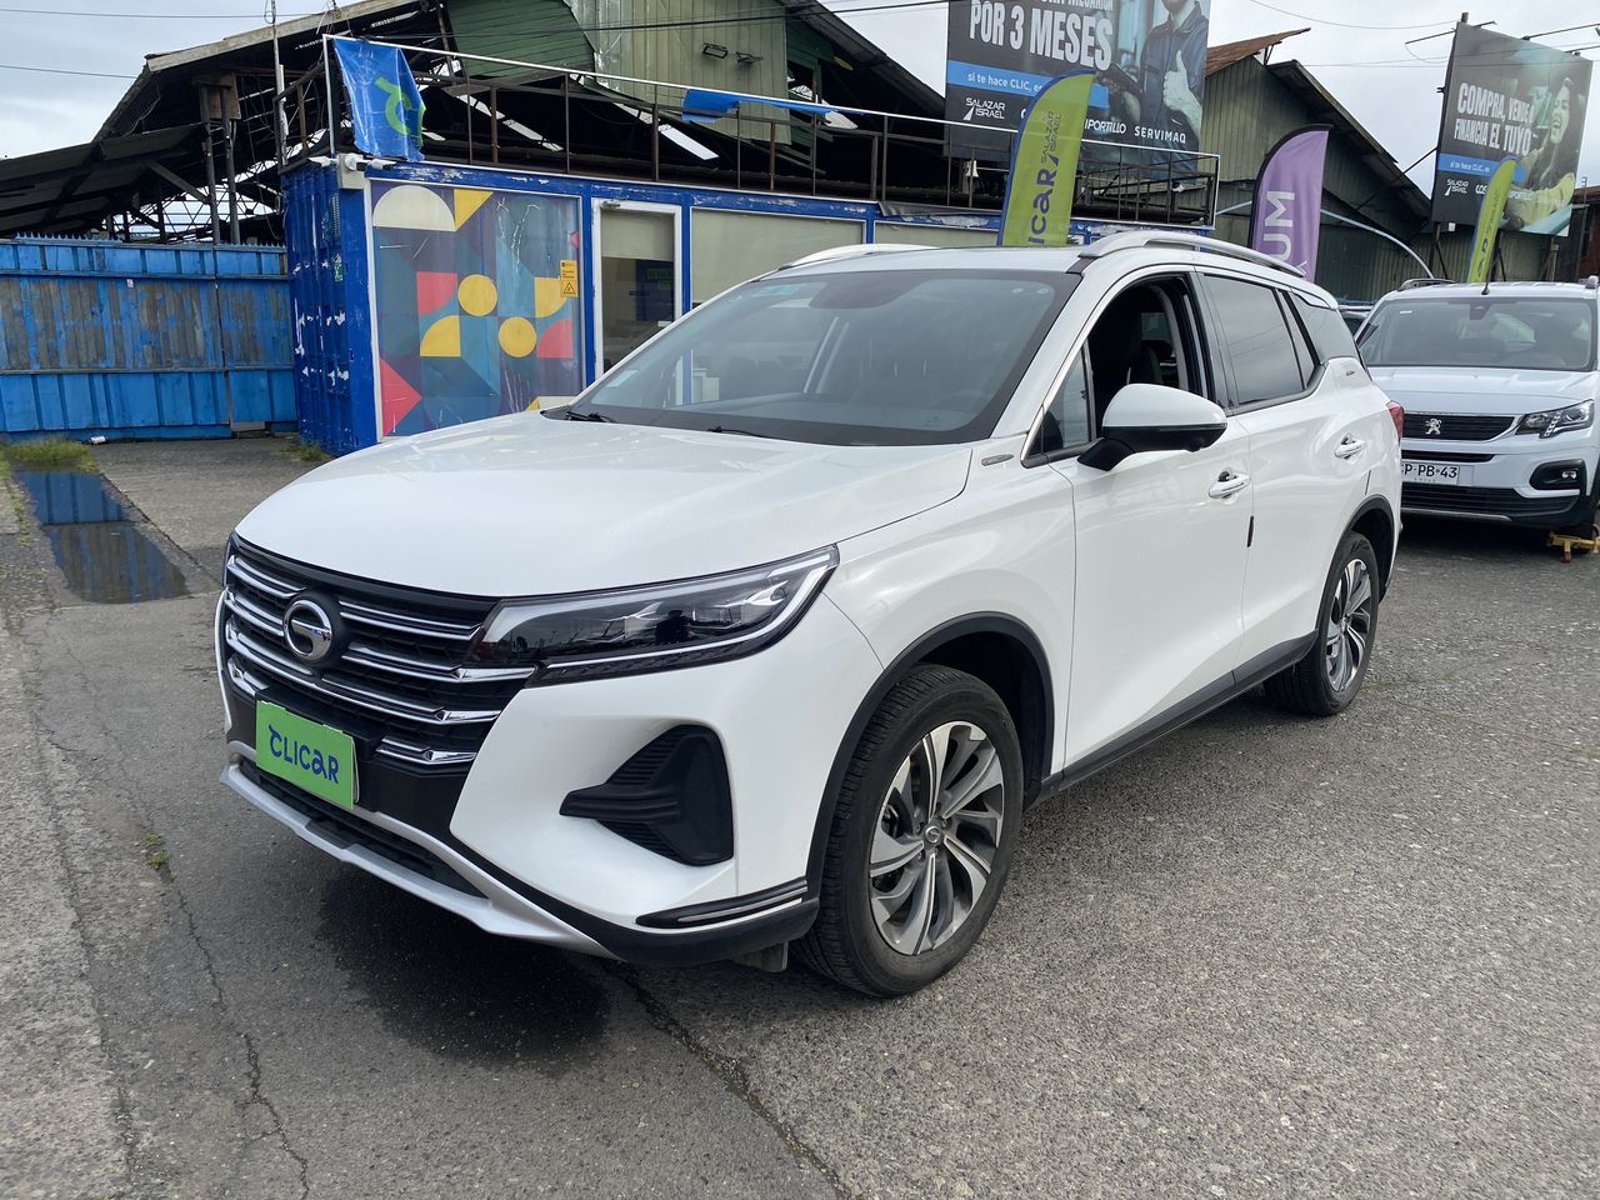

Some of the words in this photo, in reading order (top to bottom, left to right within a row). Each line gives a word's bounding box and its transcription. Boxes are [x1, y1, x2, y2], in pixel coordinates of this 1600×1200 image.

[970, 0, 1006, 46] POR
[1009, 5, 1025, 50] 3
[1029, 7, 1113, 71] MESES
[977, 73, 986, 84] te
[988, 74, 1008, 87] hace
[1009, 79, 1031, 92] CLIC,
[965, 97, 1006, 110] SALAZAR
[975, 109, 1005, 120] ISRAEL
[1457, 82, 1506, 122] COMPRA,
[1134, 126, 1187, 144] SERVIMAQ
[1454, 118, 1489, 147] FINANCIA
[1489, 123, 1501, 150] EL
[1503, 125, 1532, 156] TUYO
[1263, 191, 1296, 261] UM
